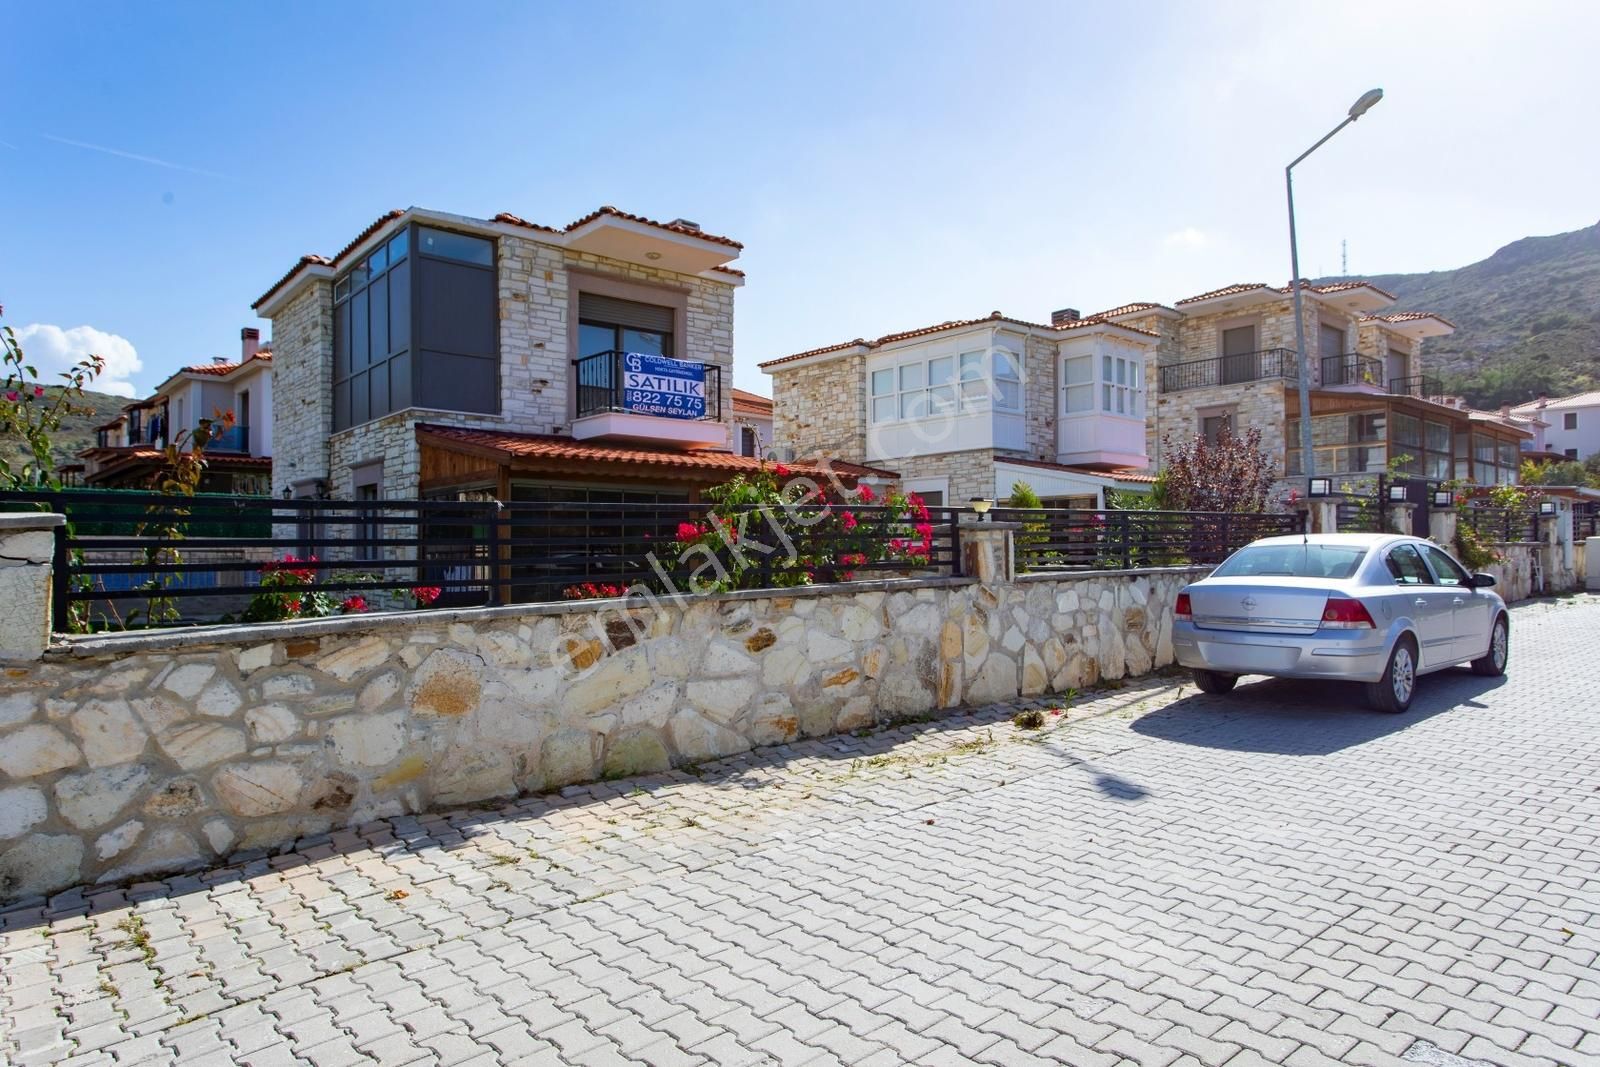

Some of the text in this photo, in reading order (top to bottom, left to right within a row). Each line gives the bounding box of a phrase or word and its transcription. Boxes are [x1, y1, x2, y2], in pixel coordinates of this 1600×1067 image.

[629, 374, 700, 395] SATILIK
[632, 391, 661, 404] 822
[665, 394, 683, 407] 75
[686, 397, 702, 409] 75
